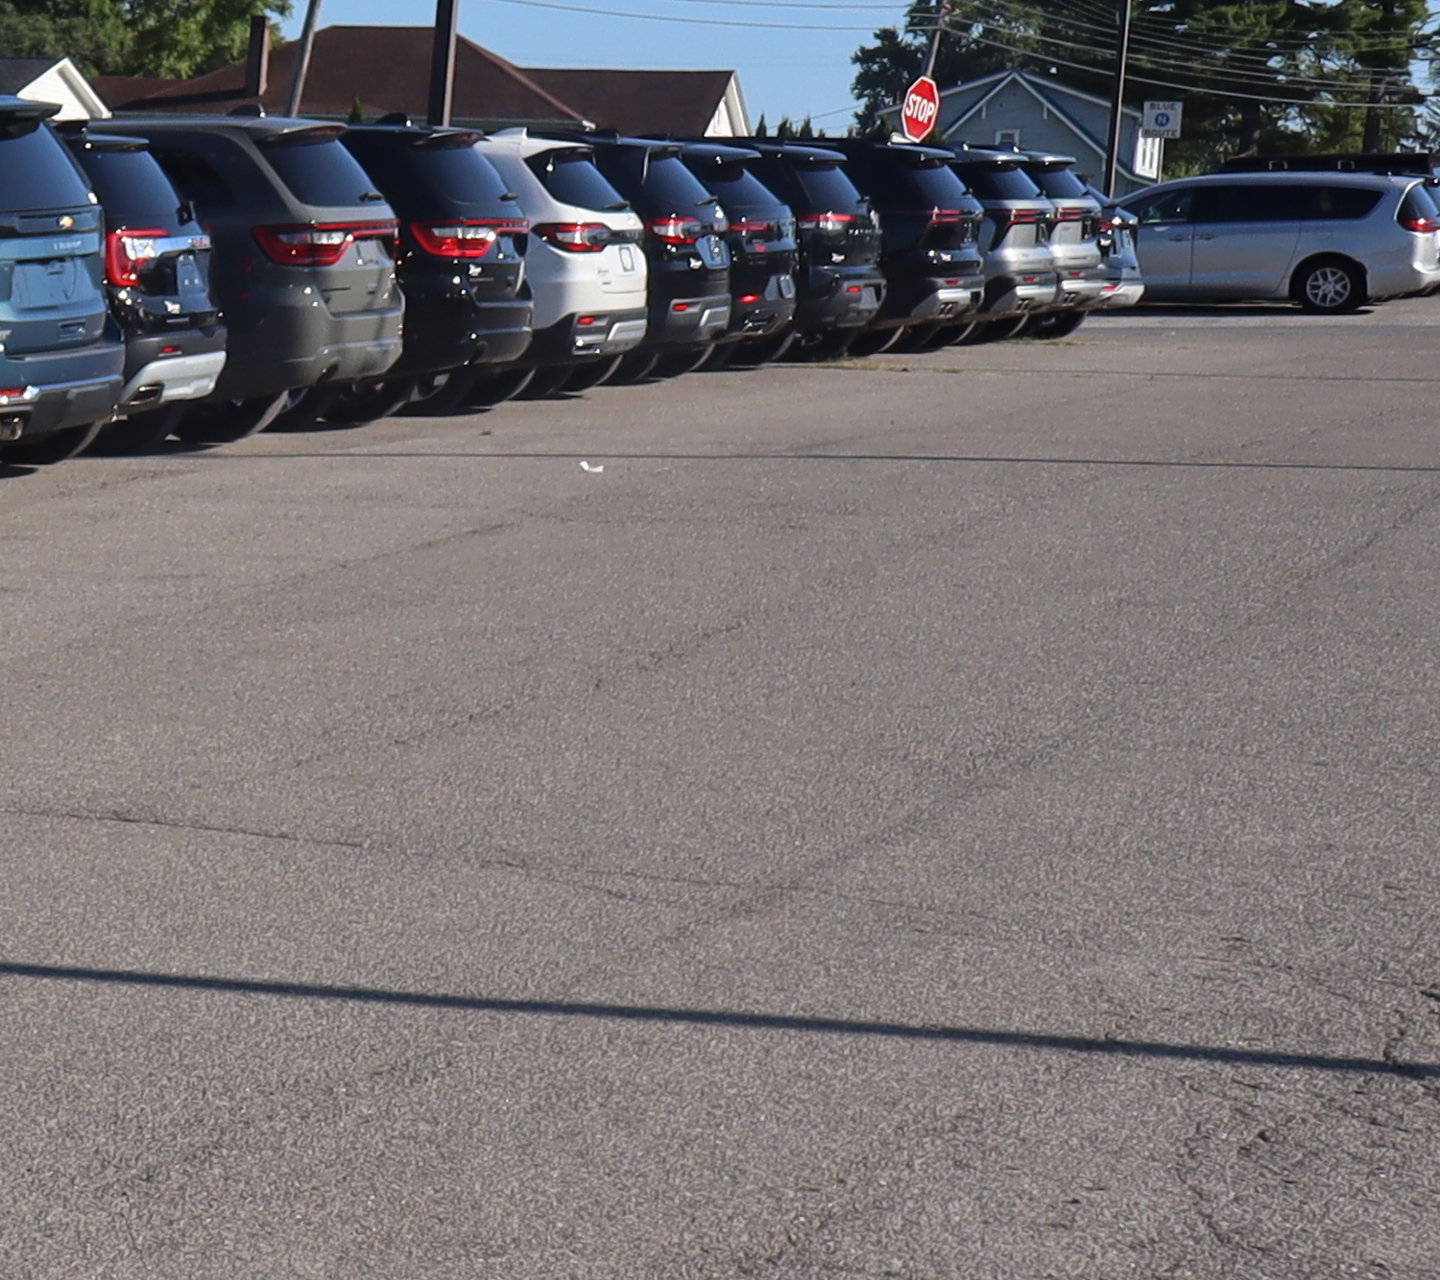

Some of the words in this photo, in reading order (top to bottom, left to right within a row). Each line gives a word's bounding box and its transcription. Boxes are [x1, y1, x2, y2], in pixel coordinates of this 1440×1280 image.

[905, 93, 935, 124] STOP
[1149, 102, 1177, 111] BLUE
[1144, 128, 1178, 137] ROUTE
